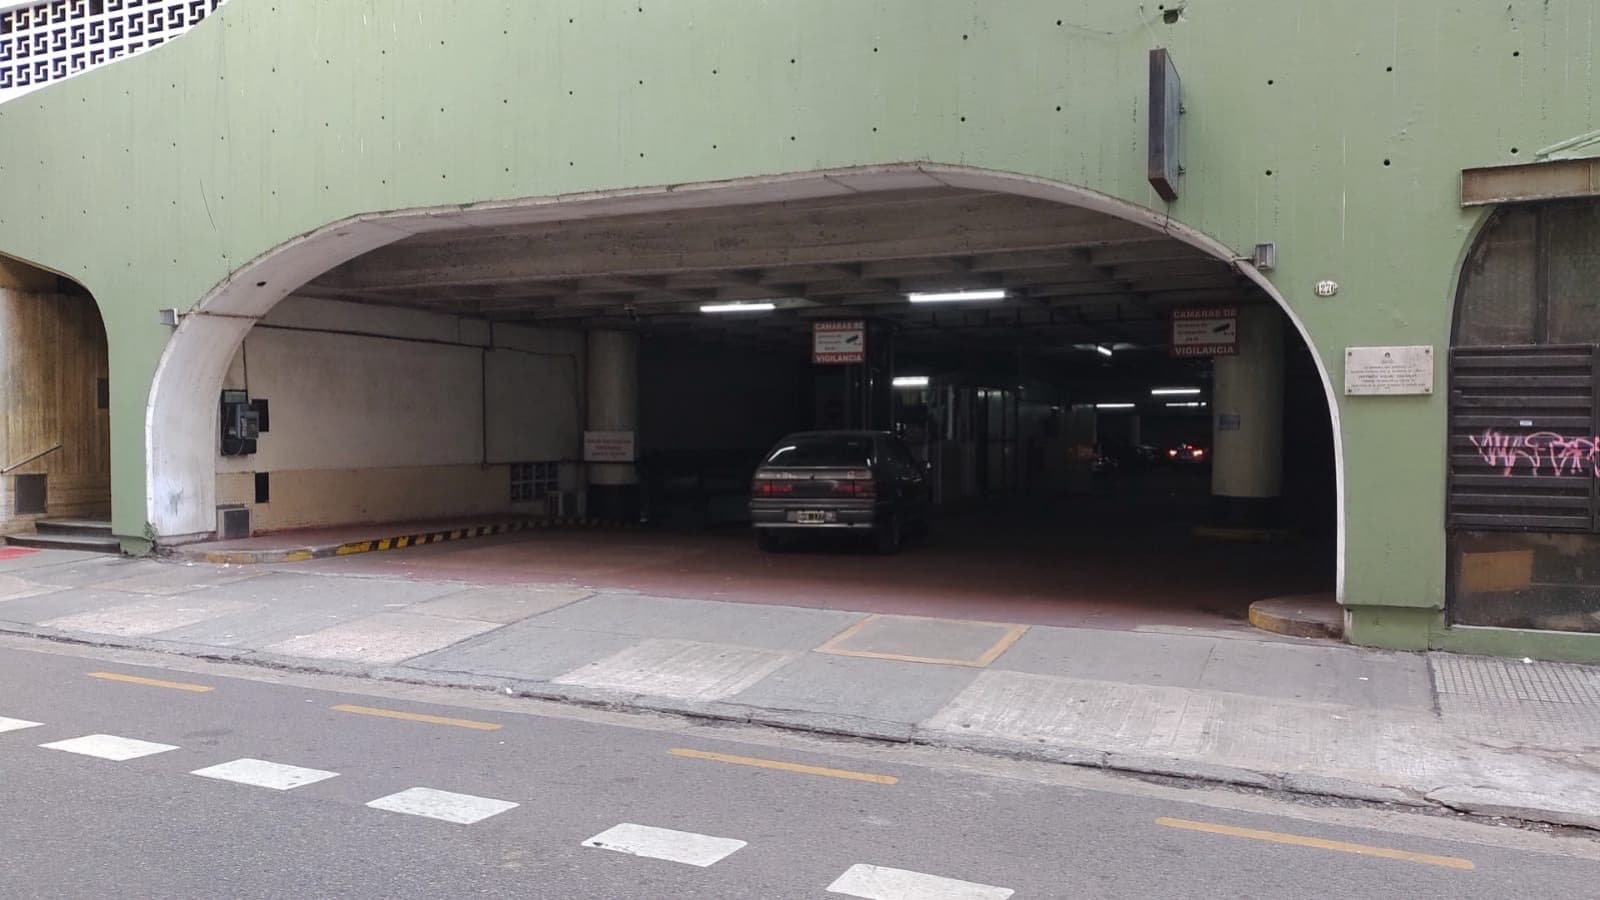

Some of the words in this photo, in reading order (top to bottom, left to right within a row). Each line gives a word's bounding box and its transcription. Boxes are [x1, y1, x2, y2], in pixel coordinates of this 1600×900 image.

[1223, 309, 1237, 317] DE
[1175, 346, 1234, 355] VIGILANCIA
[815, 353, 862, 362] VIGILANCIA
